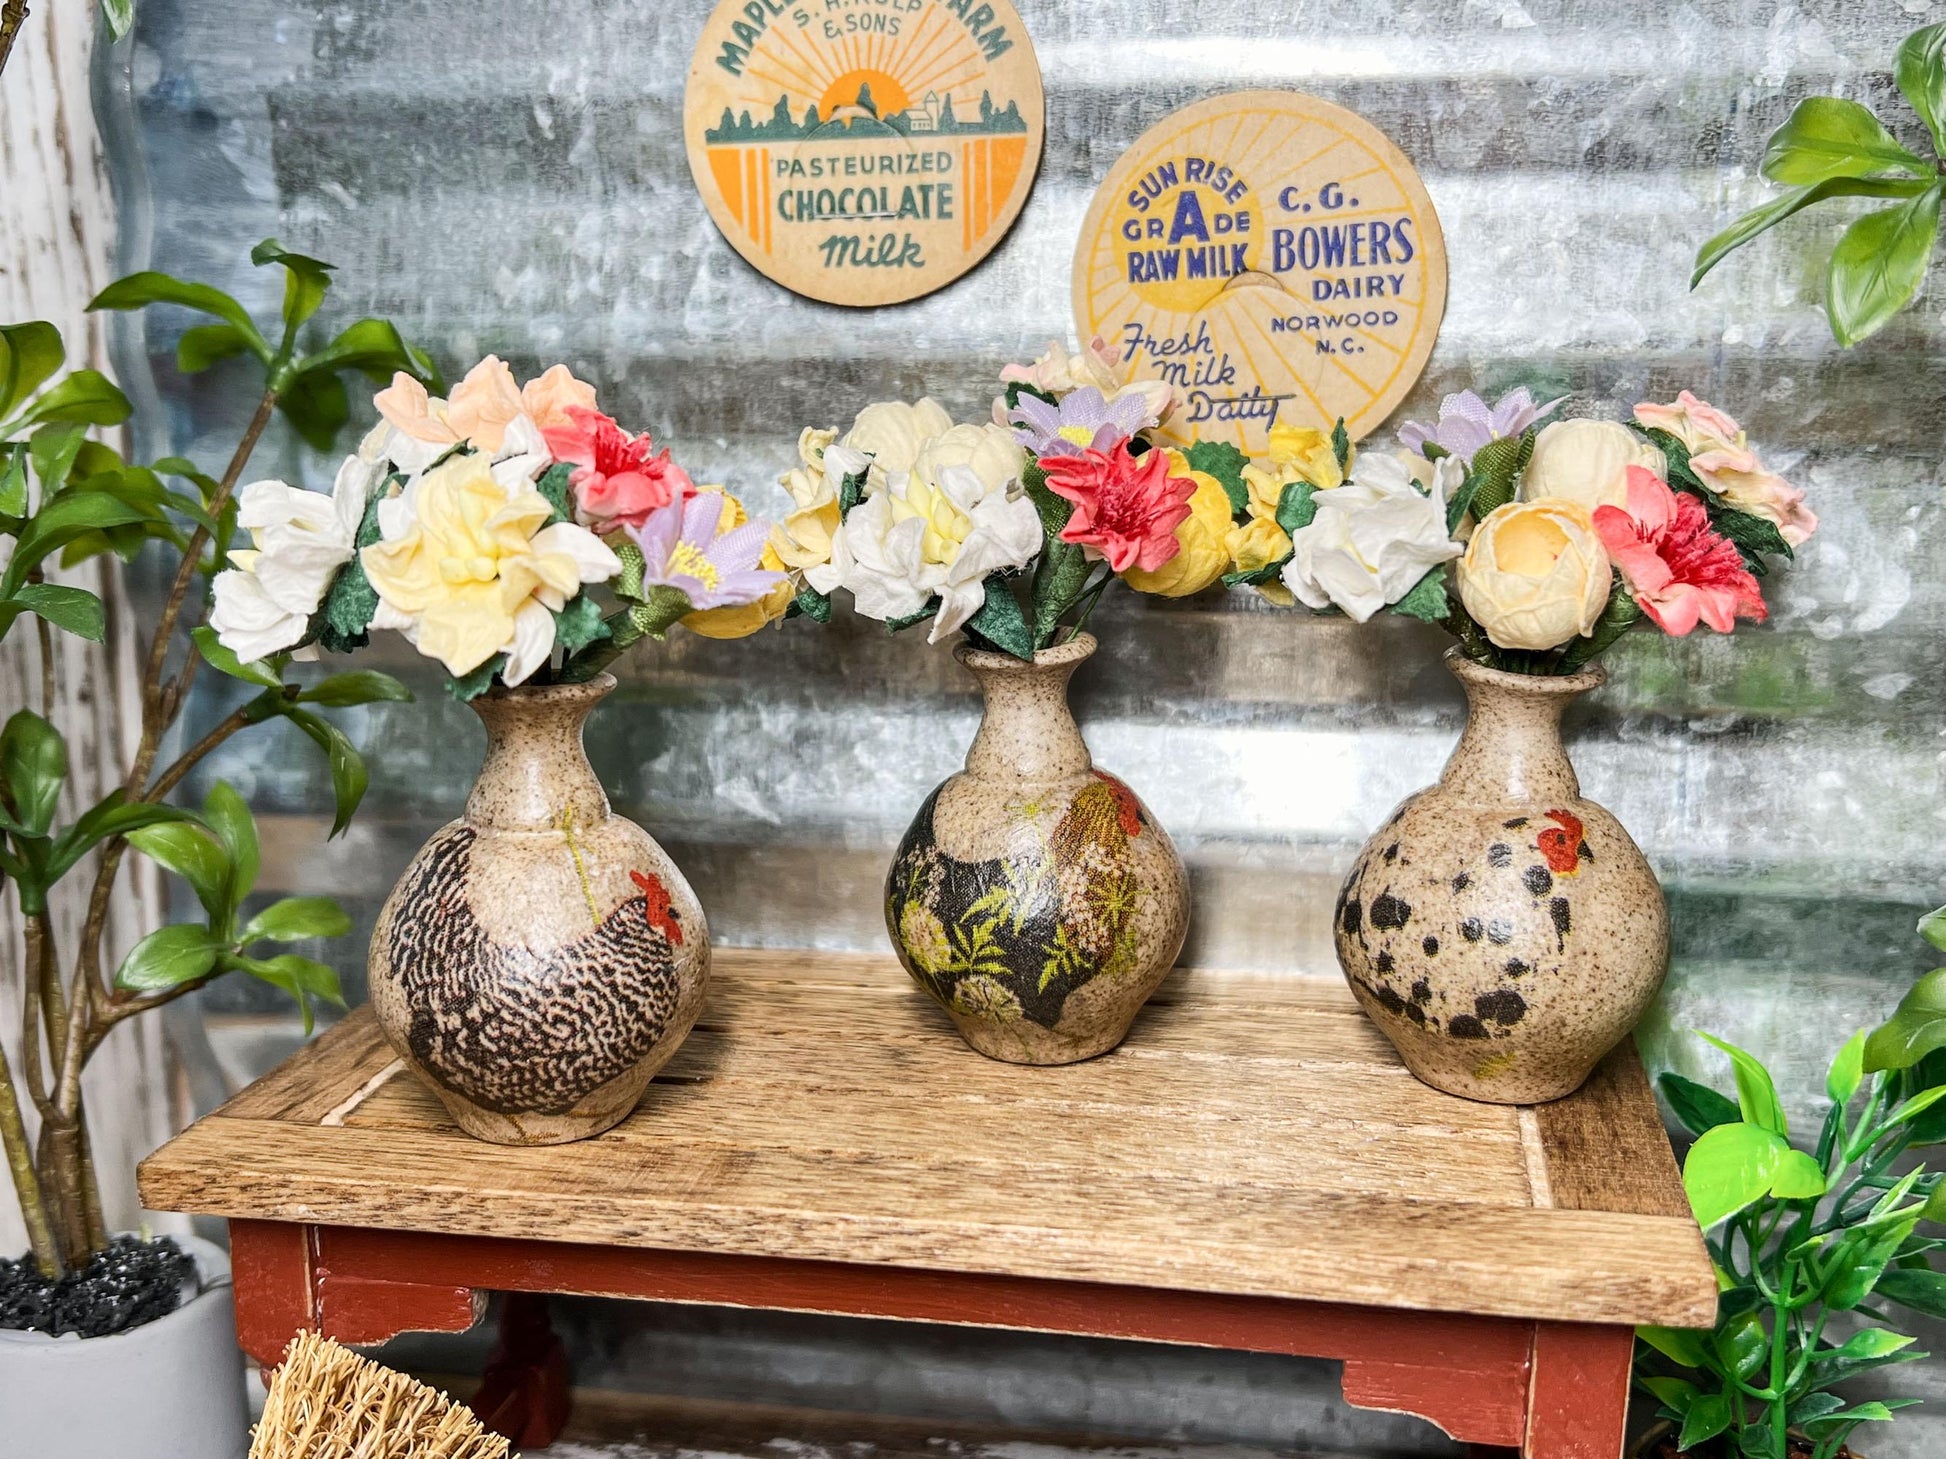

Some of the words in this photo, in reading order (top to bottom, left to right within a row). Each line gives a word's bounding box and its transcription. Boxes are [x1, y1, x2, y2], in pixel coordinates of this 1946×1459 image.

[715, 0, 797, 78] MAPL
[936, 0, 1014, 62] ARM
[823, 19, 844, 39] &
[845, 12, 902, 36] SONS
[776, 151, 953, 178] PASTEURIZED
[777, 182, 954, 222] CHOCOLATE
[819, 233, 925, 268] Milk
[1127, 248, 1180, 283] RAW
[1186, 242, 1250, 280] MILK
[1271, 217, 1414, 274] BOWERS
[1311, 273, 1406, 302] DAIRY
[1271, 310, 1399, 332] NORWOOD
[1122, 320, 1214, 361] Fresh
[1151, 357, 1236, 387] Milk
